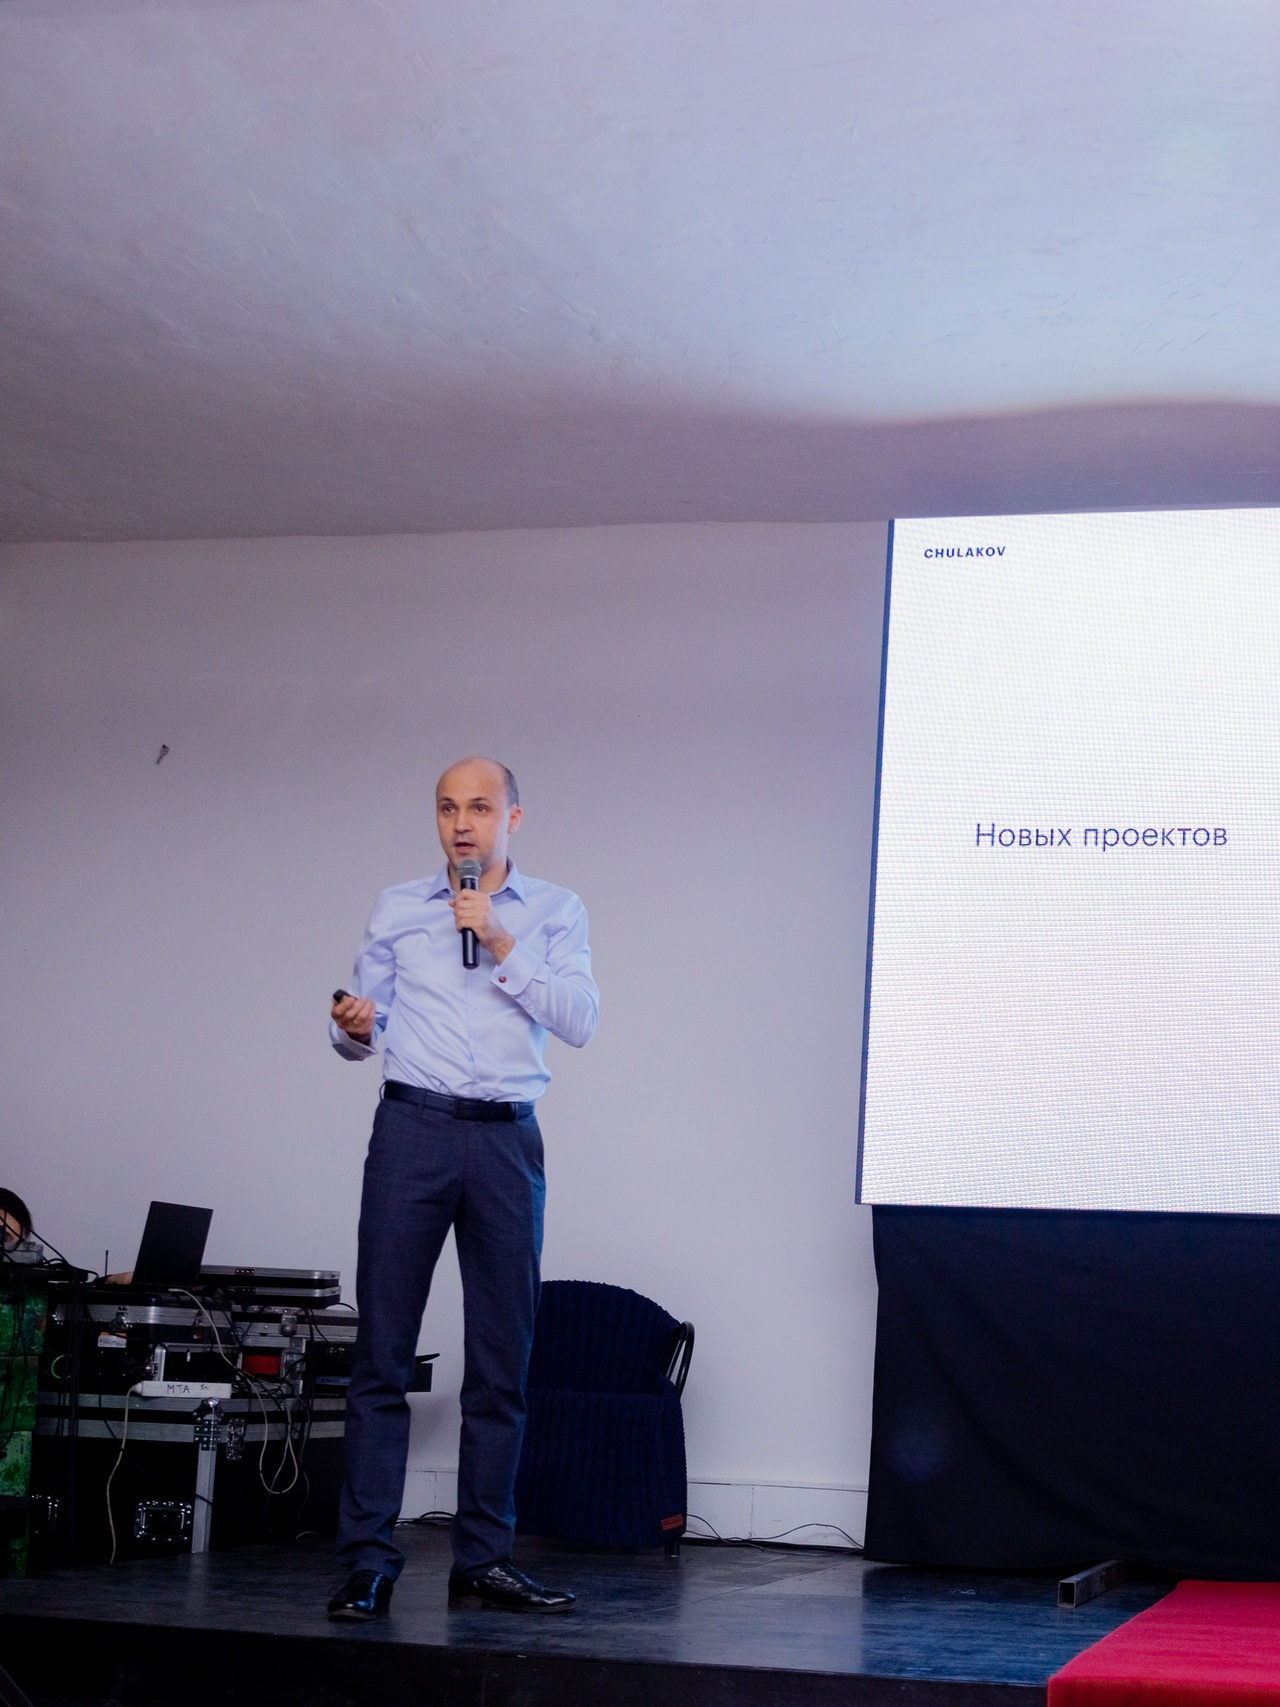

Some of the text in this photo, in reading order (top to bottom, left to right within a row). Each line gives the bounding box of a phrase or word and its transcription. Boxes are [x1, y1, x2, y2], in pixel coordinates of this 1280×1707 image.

[923, 546, 1006, 559] CHULAKOV
[976, 823, 1228, 852] Новых проектов
